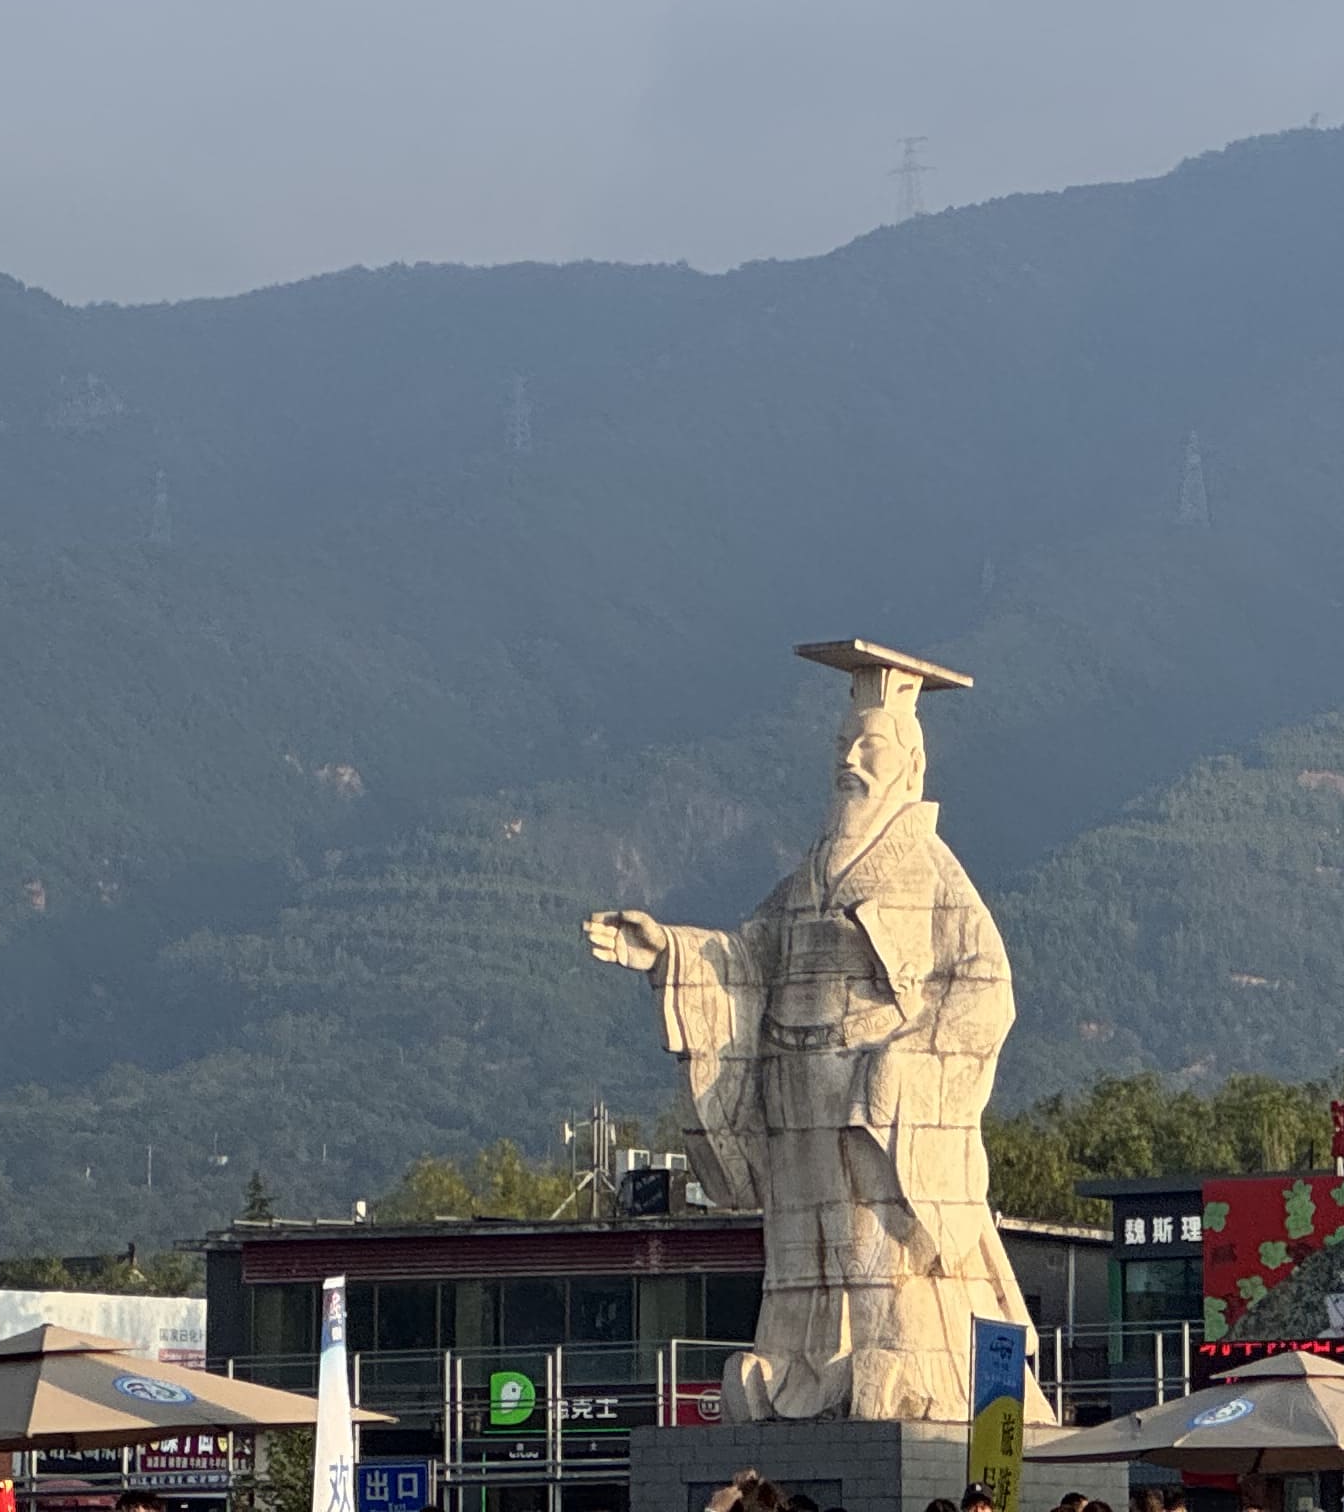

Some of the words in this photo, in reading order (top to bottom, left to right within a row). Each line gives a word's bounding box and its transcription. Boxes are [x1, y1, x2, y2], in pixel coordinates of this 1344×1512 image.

[1124, 1216, 1202, 1245] 魏斯理
[365, 1470, 419, 1501] 出口
